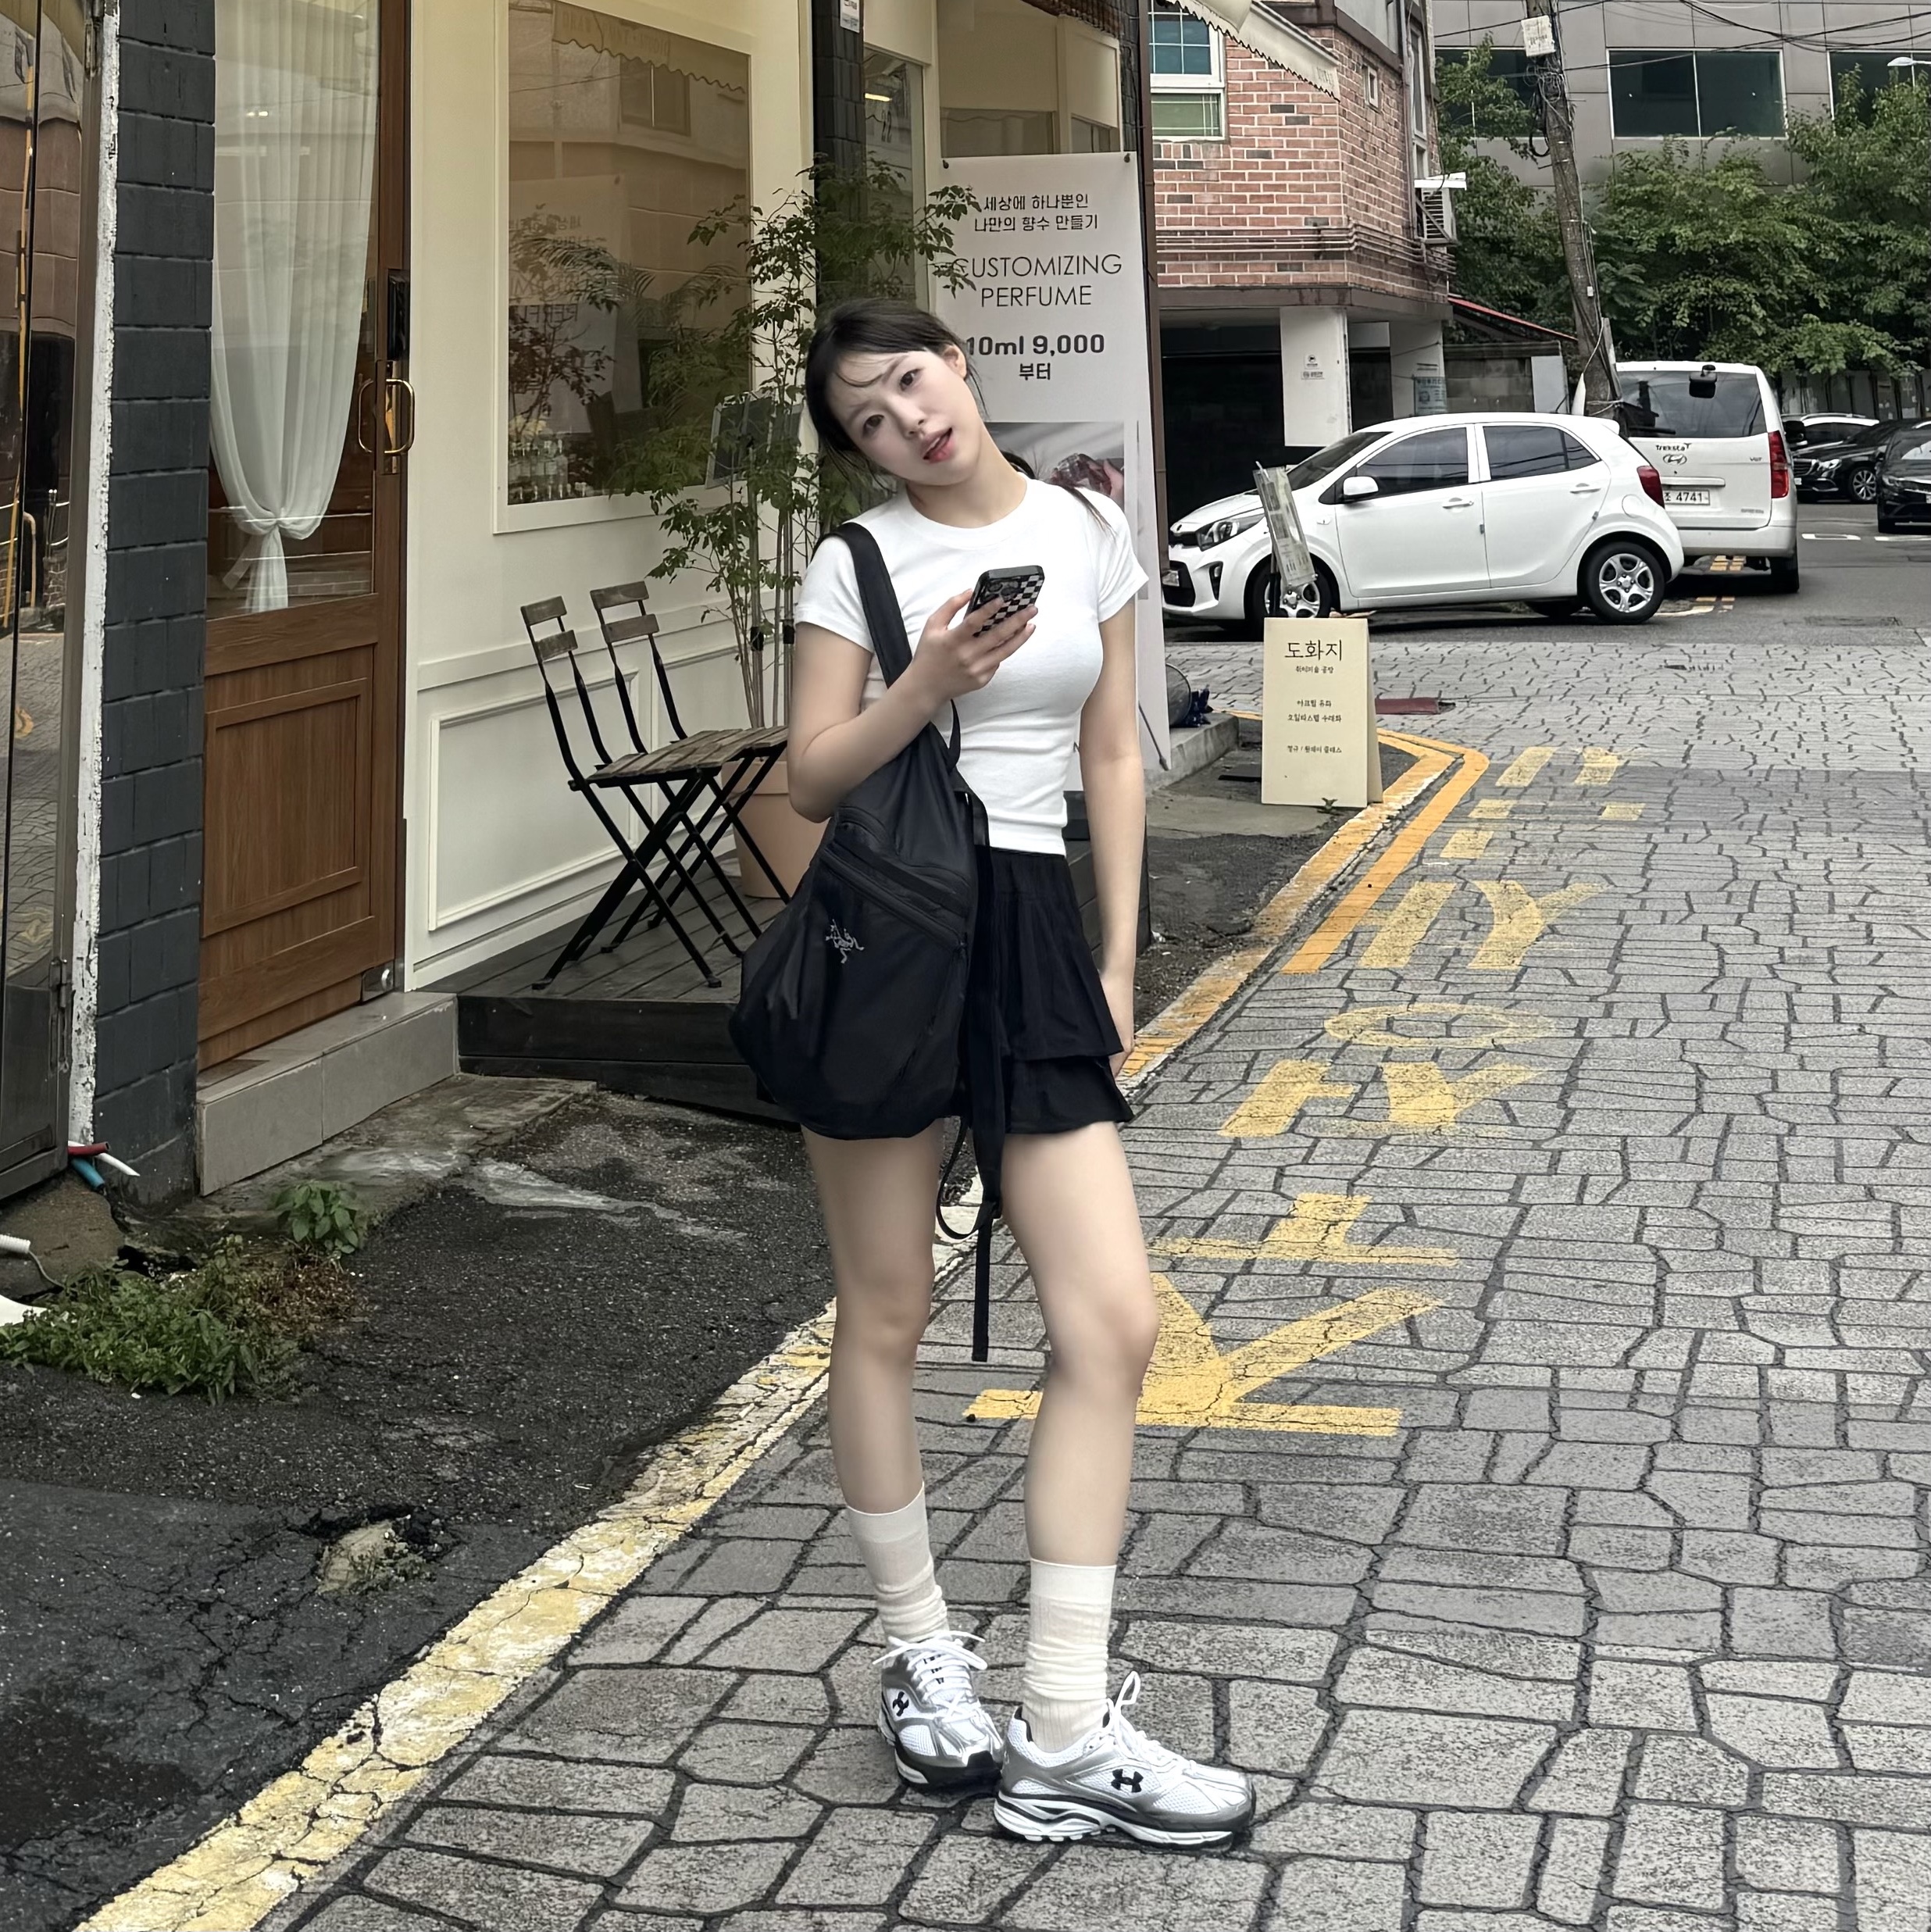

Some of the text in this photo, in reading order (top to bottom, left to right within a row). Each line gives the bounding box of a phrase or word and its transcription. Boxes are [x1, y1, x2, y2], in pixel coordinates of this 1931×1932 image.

[984, 193, 1089, 211] 세상에 하나뿐인
[974, 214, 1098, 232] 나만의 향수 만들기
[952, 253, 1123, 278] CUSTOMIZING
[981, 284, 1092, 307] PERFUME
[966, 334, 1105, 356] 10ml 9,000
[1019, 362, 1051, 381] 부터
[1676, 491, 1702, 502] 4741
[1284, 639, 1343, 662] 도화지
